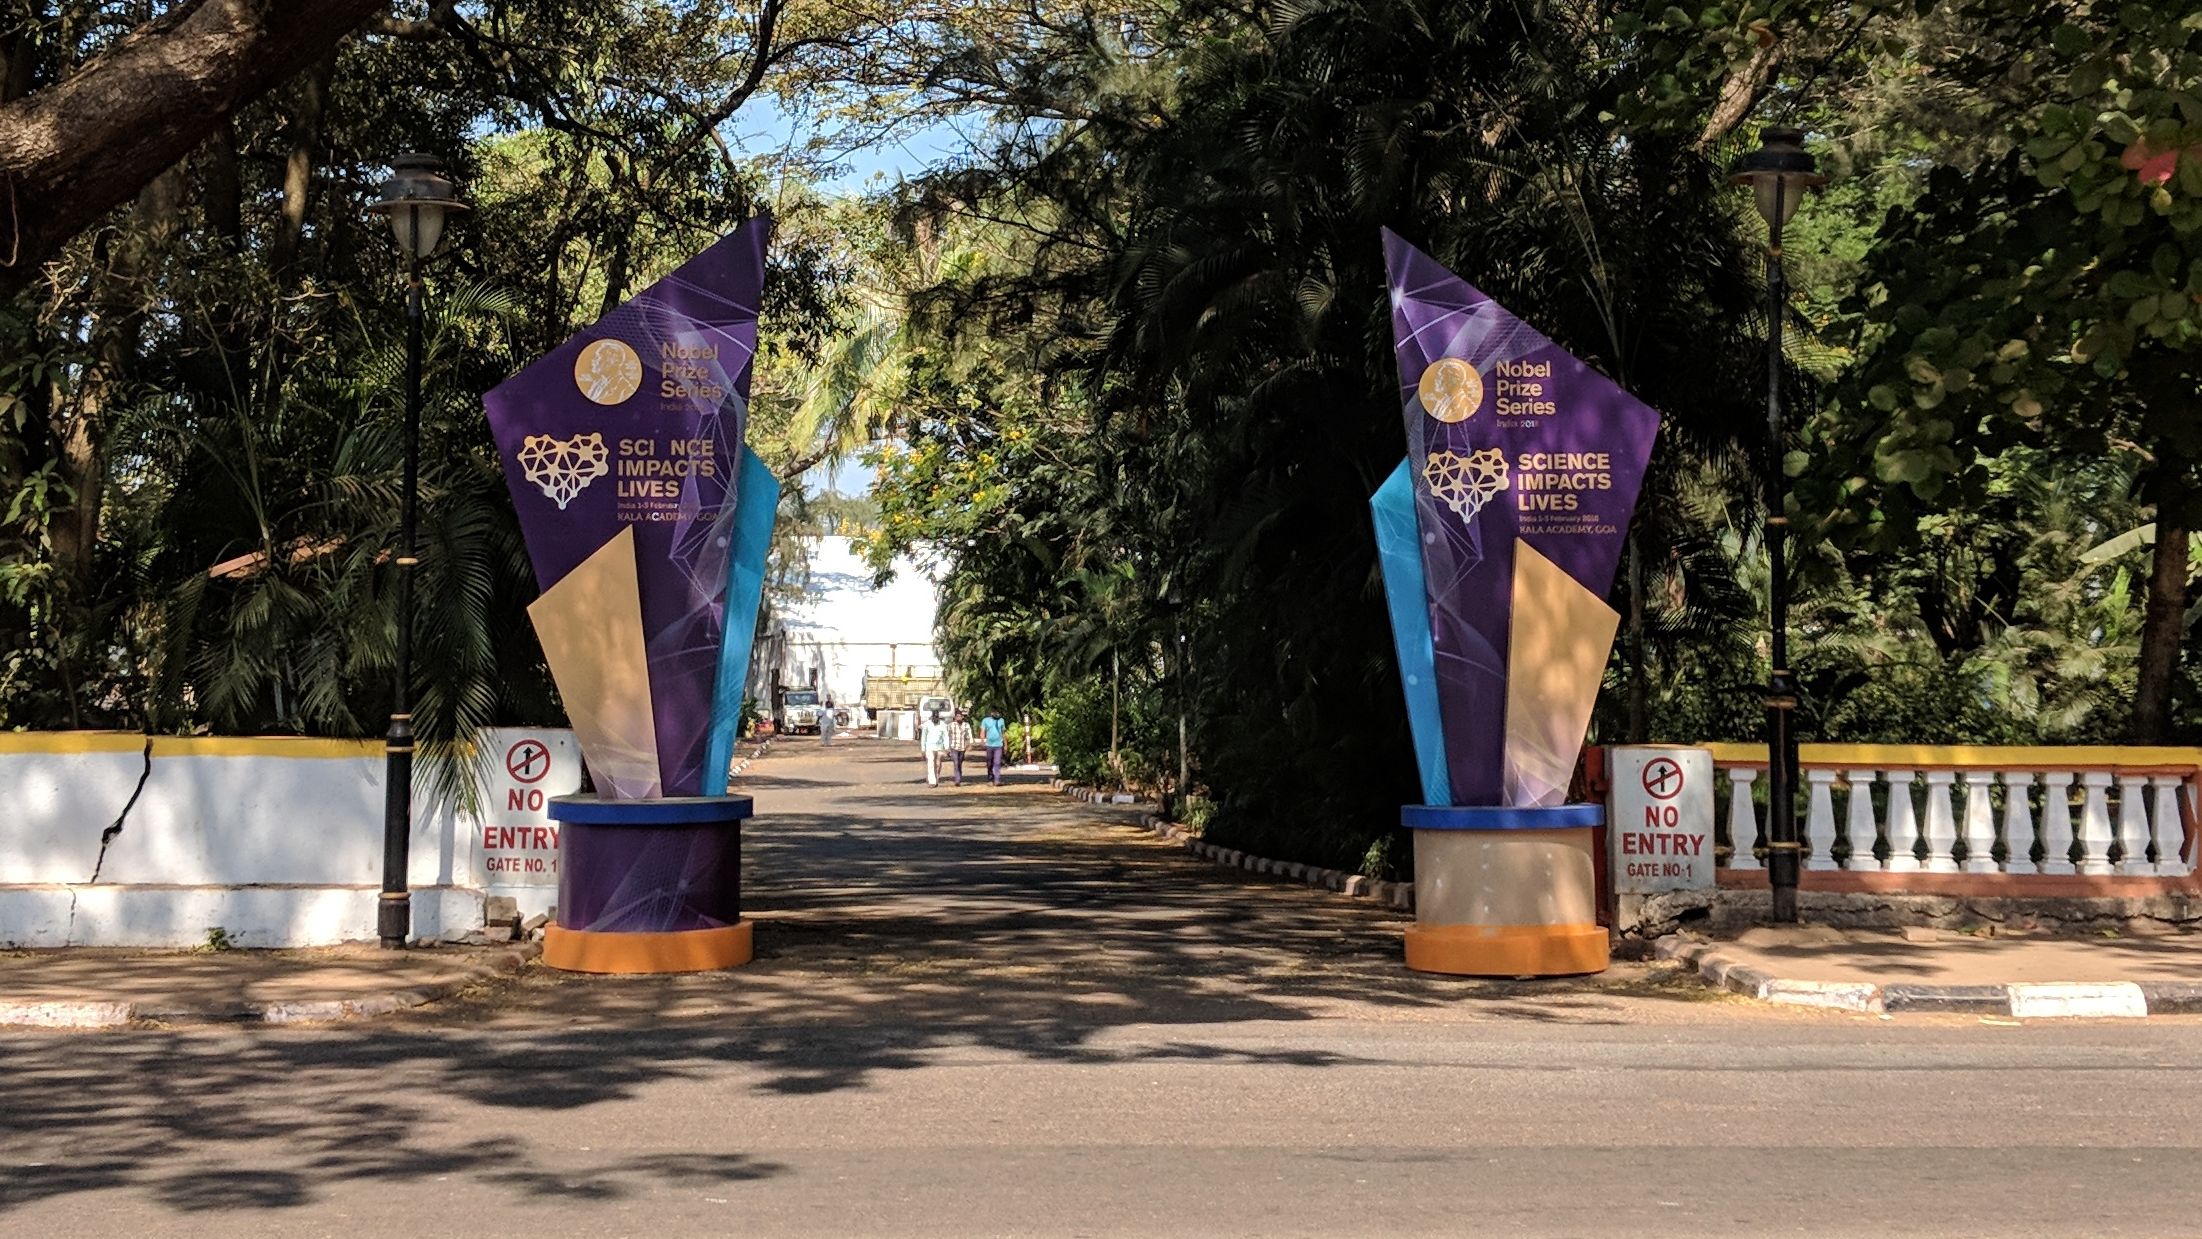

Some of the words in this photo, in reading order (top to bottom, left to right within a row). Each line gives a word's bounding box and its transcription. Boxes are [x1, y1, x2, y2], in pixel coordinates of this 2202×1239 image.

[662, 342, 718, 359] Nobel
[662, 361, 708, 379] Prize
[1496, 360, 1551, 377] Nobel
[661, 380, 722, 398] Series
[1496, 380, 1543, 396] Prize
[1496, 398, 1556, 415] Series
[619, 439, 715, 456] SCINCE
[617, 460, 715, 477] IMPACTS
[1518, 453, 1610, 470] SCIENCE
[617, 480, 680, 498] LIVES
[1518, 473, 1612, 490] IMPACTS
[1518, 494, 1578, 511] LIVES
[618, 513, 643, 521] KALA
[1520, 525, 1544, 534] KALA
[1595, 525, 1616, 534] GOA
[508, 788, 543, 811] NO
[1645, 806, 1678, 828] NO
[484, 826, 559, 849] ENTRY
[1622, 832, 1704, 856] ENTRY
[487, 857, 520, 872] GATE
[525, 858, 546, 872] NO.
[552, 859, 557, 872] 1
[1628, 863, 1659, 877] GATE
